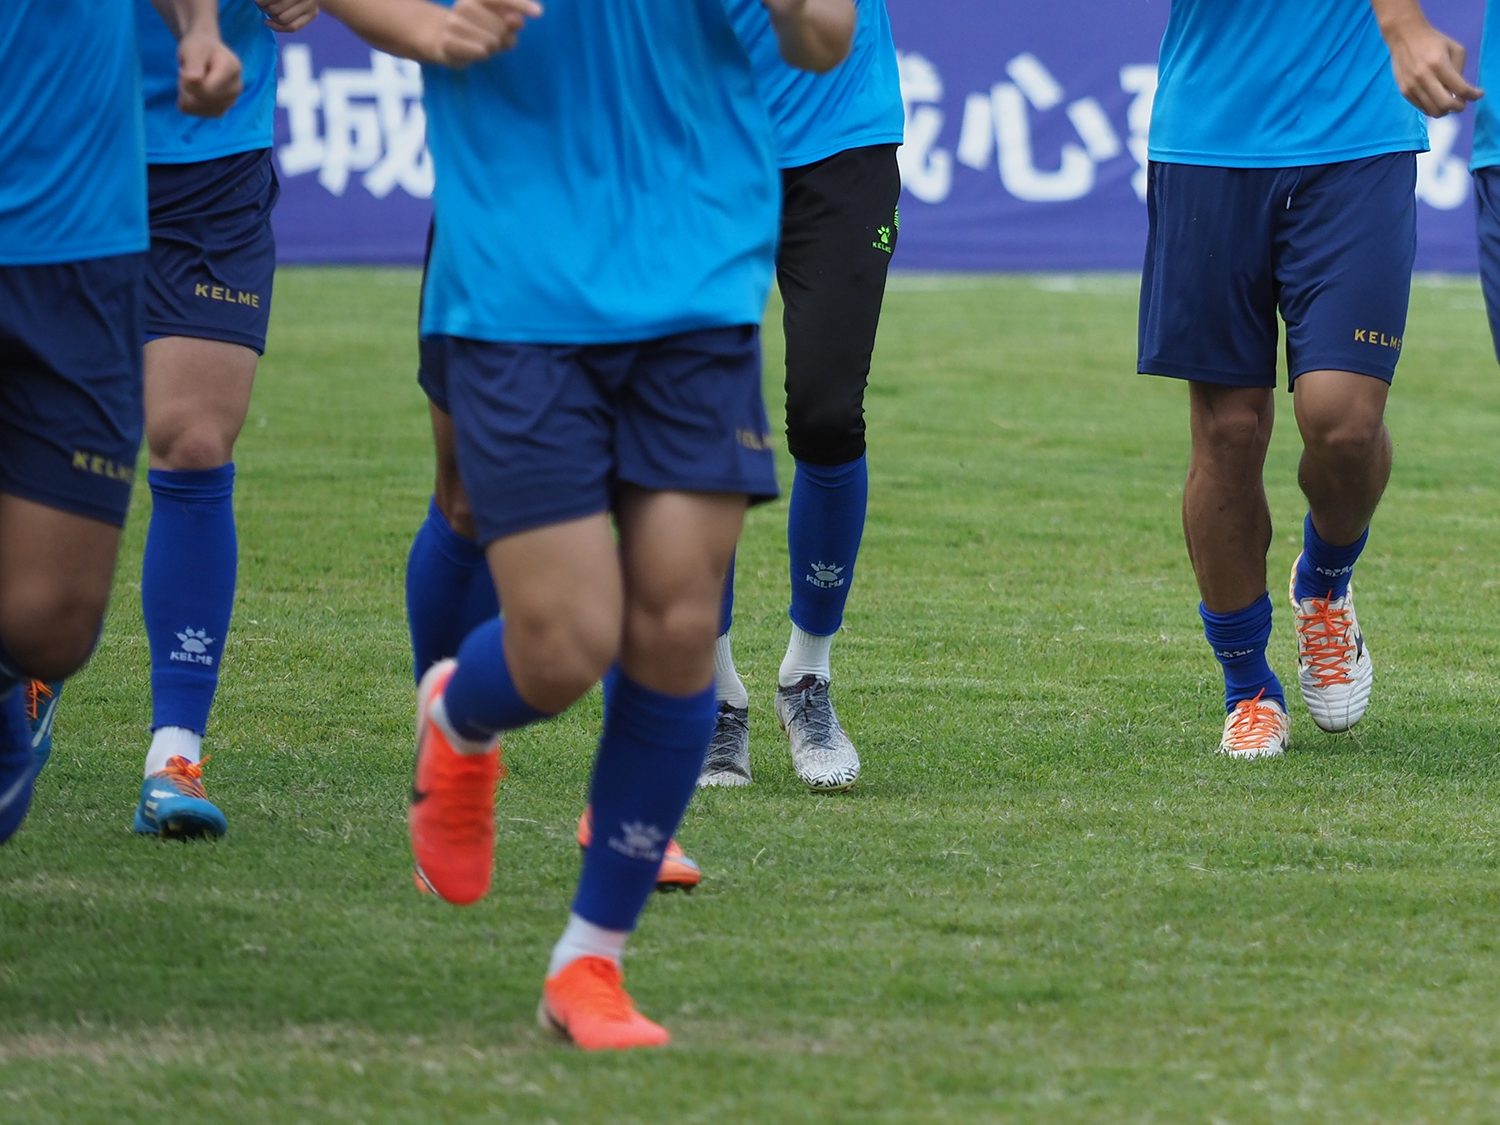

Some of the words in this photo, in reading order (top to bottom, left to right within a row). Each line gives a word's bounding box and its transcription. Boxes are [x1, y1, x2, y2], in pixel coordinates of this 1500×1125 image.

[277, 43, 436, 200] 城
[195, 283, 259, 308] KELME
[806, 574, 845, 589] KELME
[170, 651, 213, 666] KELME
